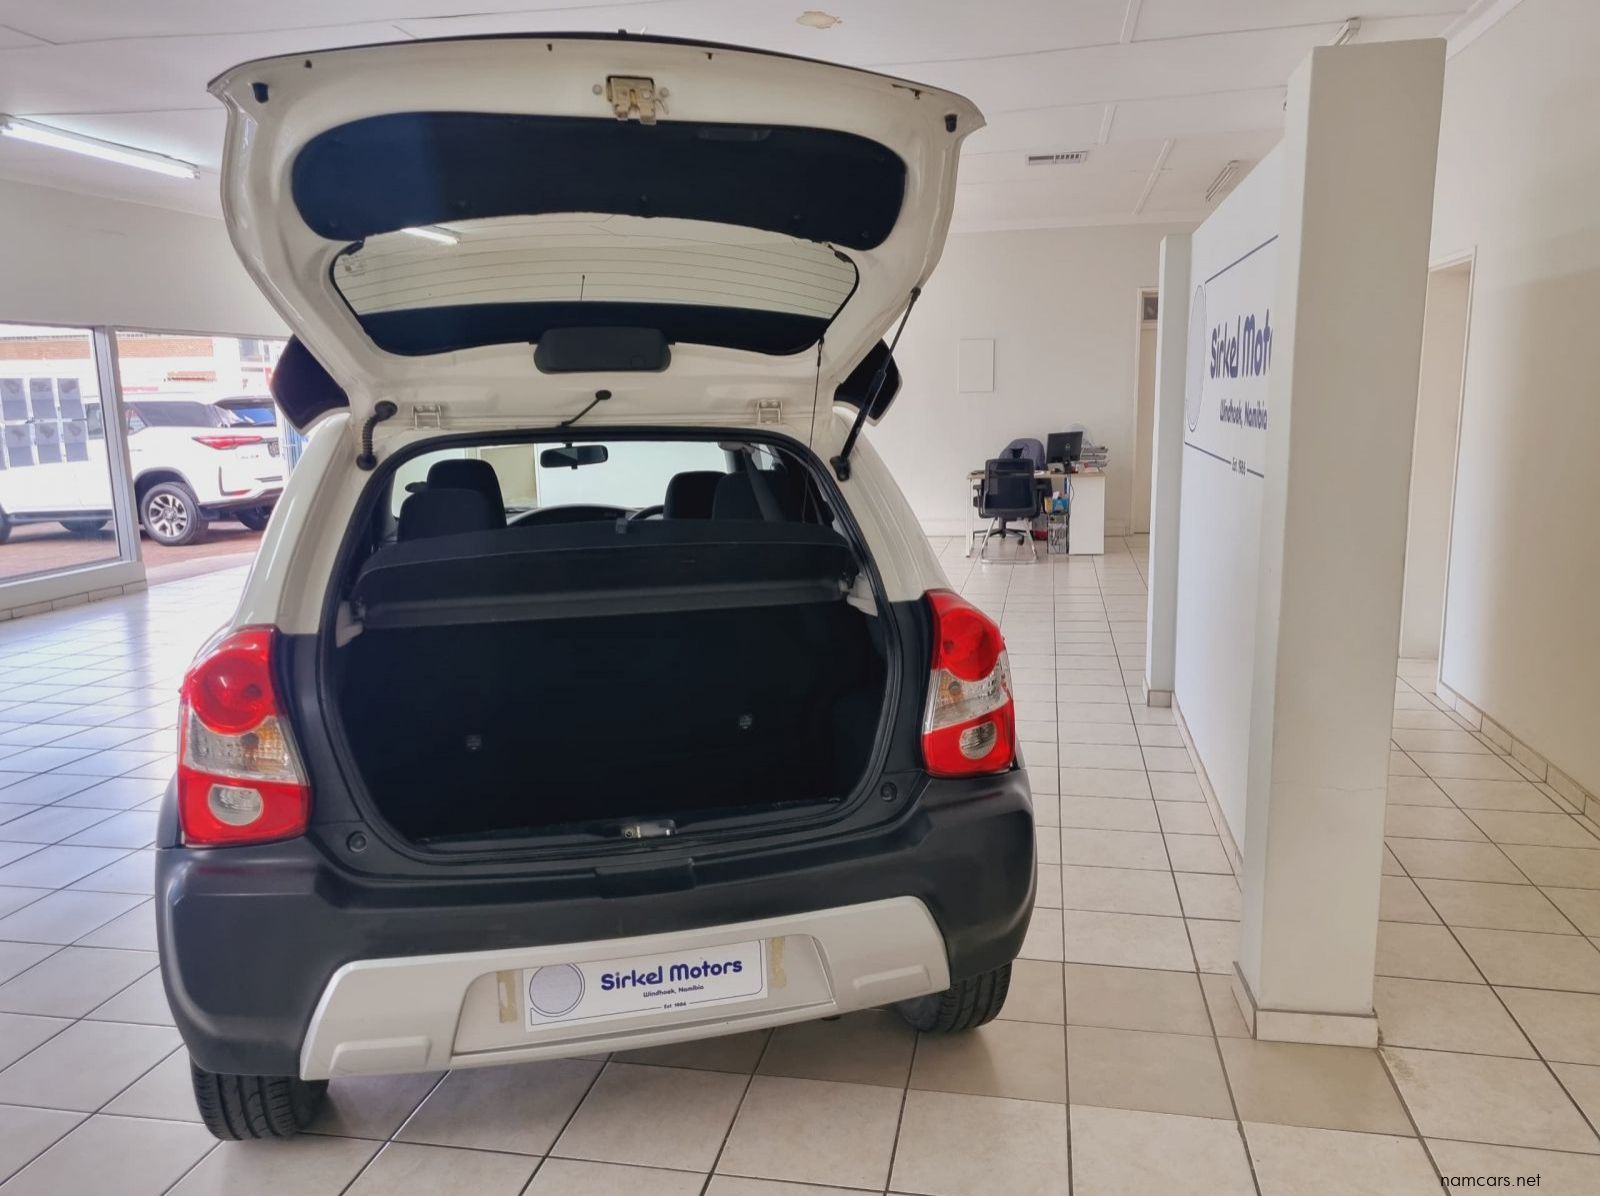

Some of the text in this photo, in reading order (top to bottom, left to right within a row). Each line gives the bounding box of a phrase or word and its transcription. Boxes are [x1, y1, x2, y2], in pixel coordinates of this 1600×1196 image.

[1210, 314, 1241, 379] Sirkel
[600, 960, 743, 991] Sirkel Motors
[678, 984, 704, 993] Namibia
